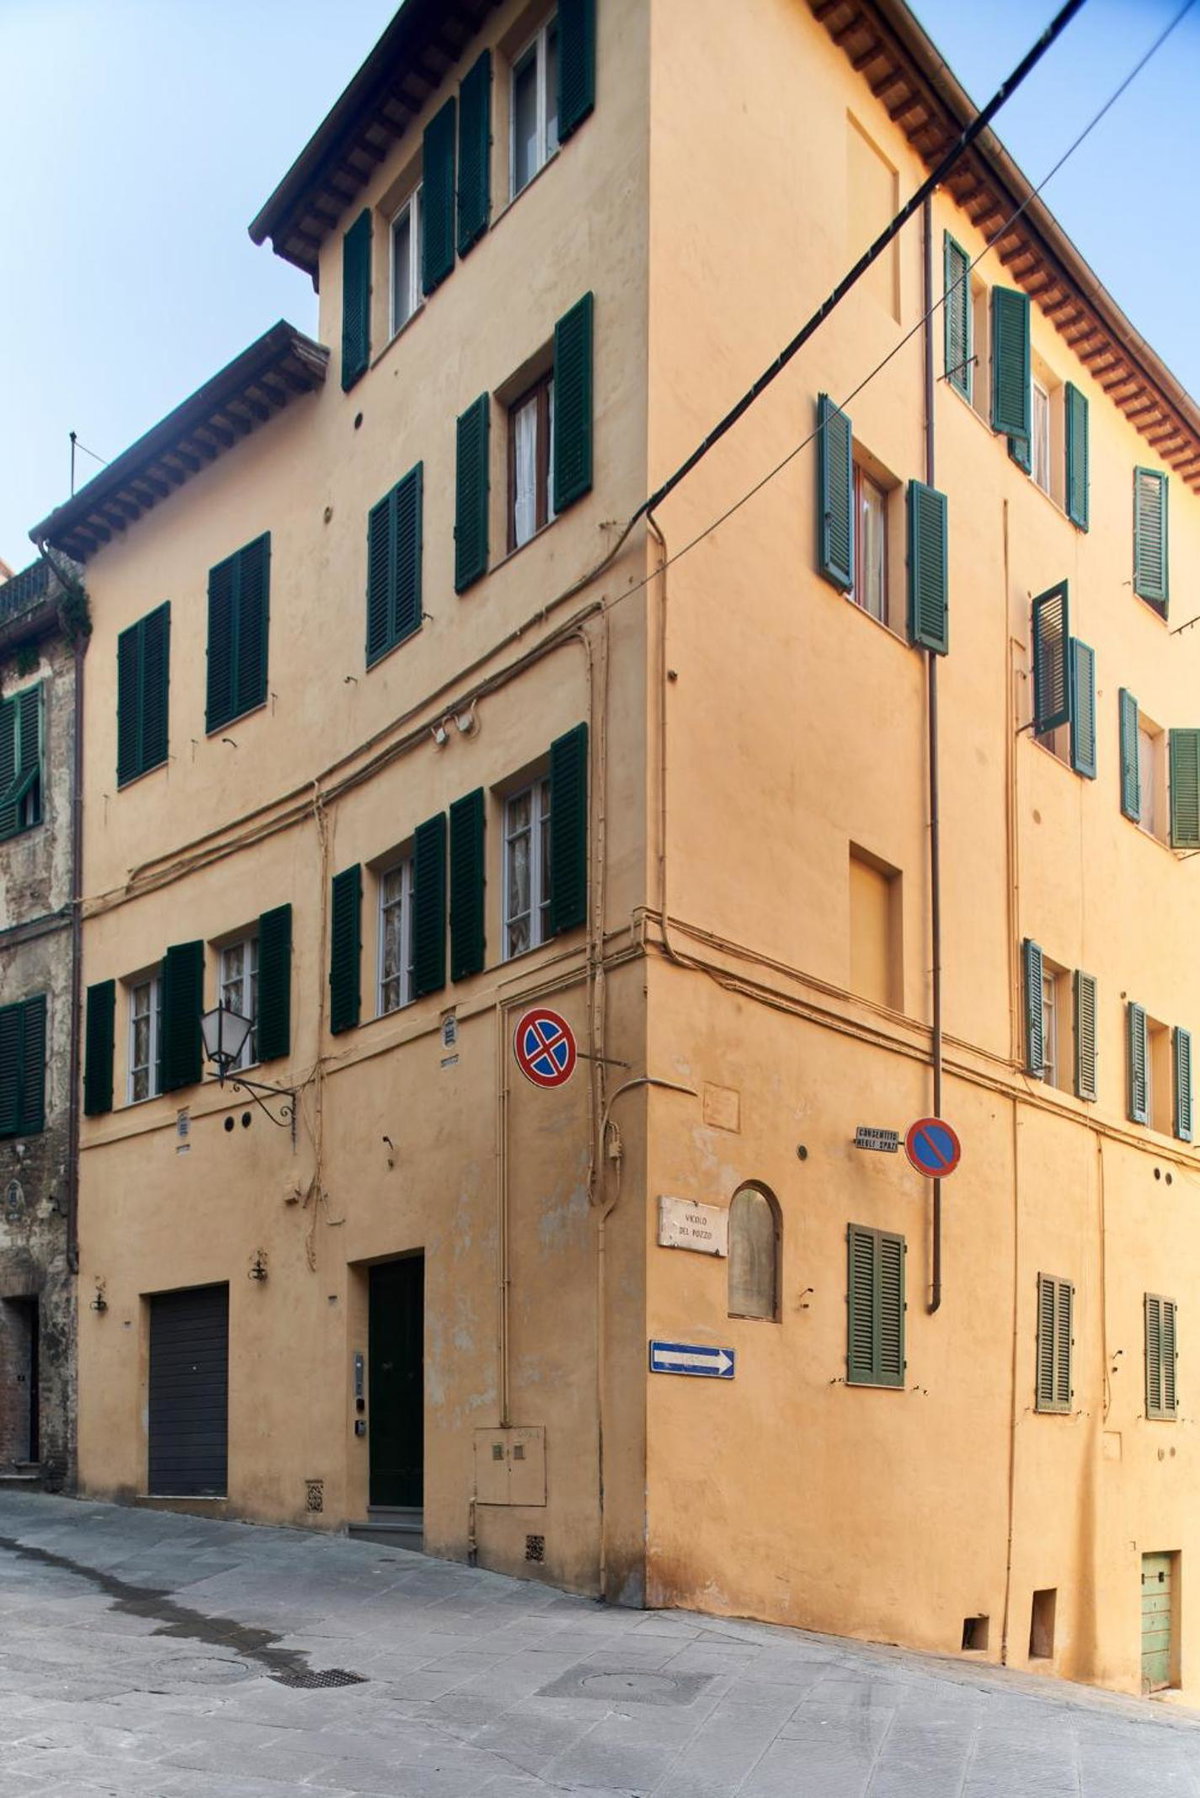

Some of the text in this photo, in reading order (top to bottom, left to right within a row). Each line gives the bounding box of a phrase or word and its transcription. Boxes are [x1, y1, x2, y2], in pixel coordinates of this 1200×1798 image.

[859, 1128, 897, 1140] CONSENTITO
[685, 1214, 707, 1225] VICOLO
[679, 1226, 712, 1240] DEL POZZO
